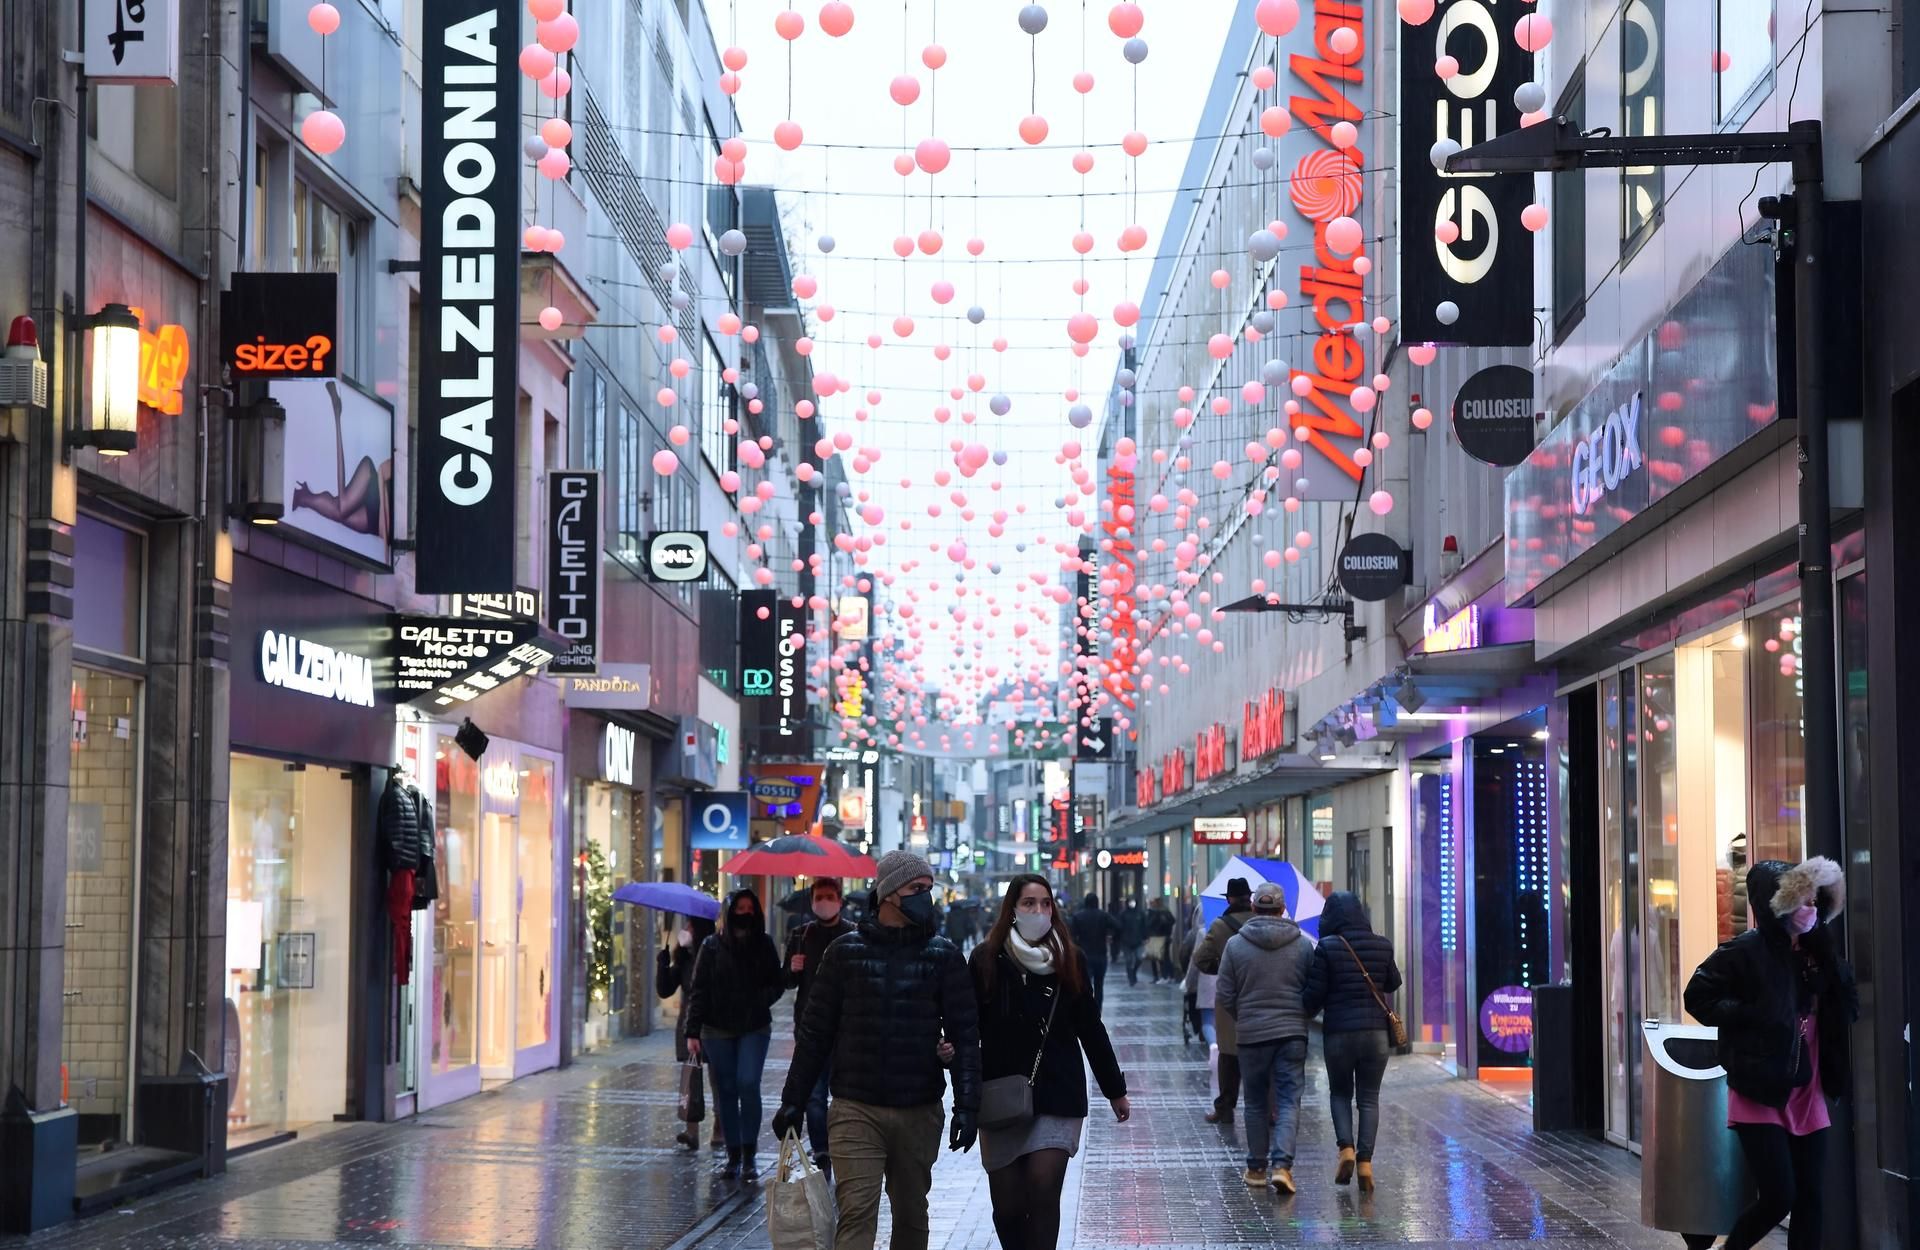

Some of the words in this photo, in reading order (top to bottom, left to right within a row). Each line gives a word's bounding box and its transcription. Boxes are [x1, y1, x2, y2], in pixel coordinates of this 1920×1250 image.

[1434, 0, 1499, 284] GEO
[439, 8, 498, 507] CALZEDONIA
[235, 335, 332, 371] size?
[1570, 387, 1643, 515] GEOX
[557, 477, 588, 639] CALETTO
[651, 549, 701, 565] ONLY
[1343, 555, 1399, 570] COLLOSEUM
[261, 629, 375, 708] CALZEDONIA
[400, 626, 514, 647] CALETTO
[563, 644, 593, 655] UNG
[778, 618, 796, 736] FOSSIL
[605, 721, 636, 787] ONLY
[754, 785, 797, 798] FOSSIL
